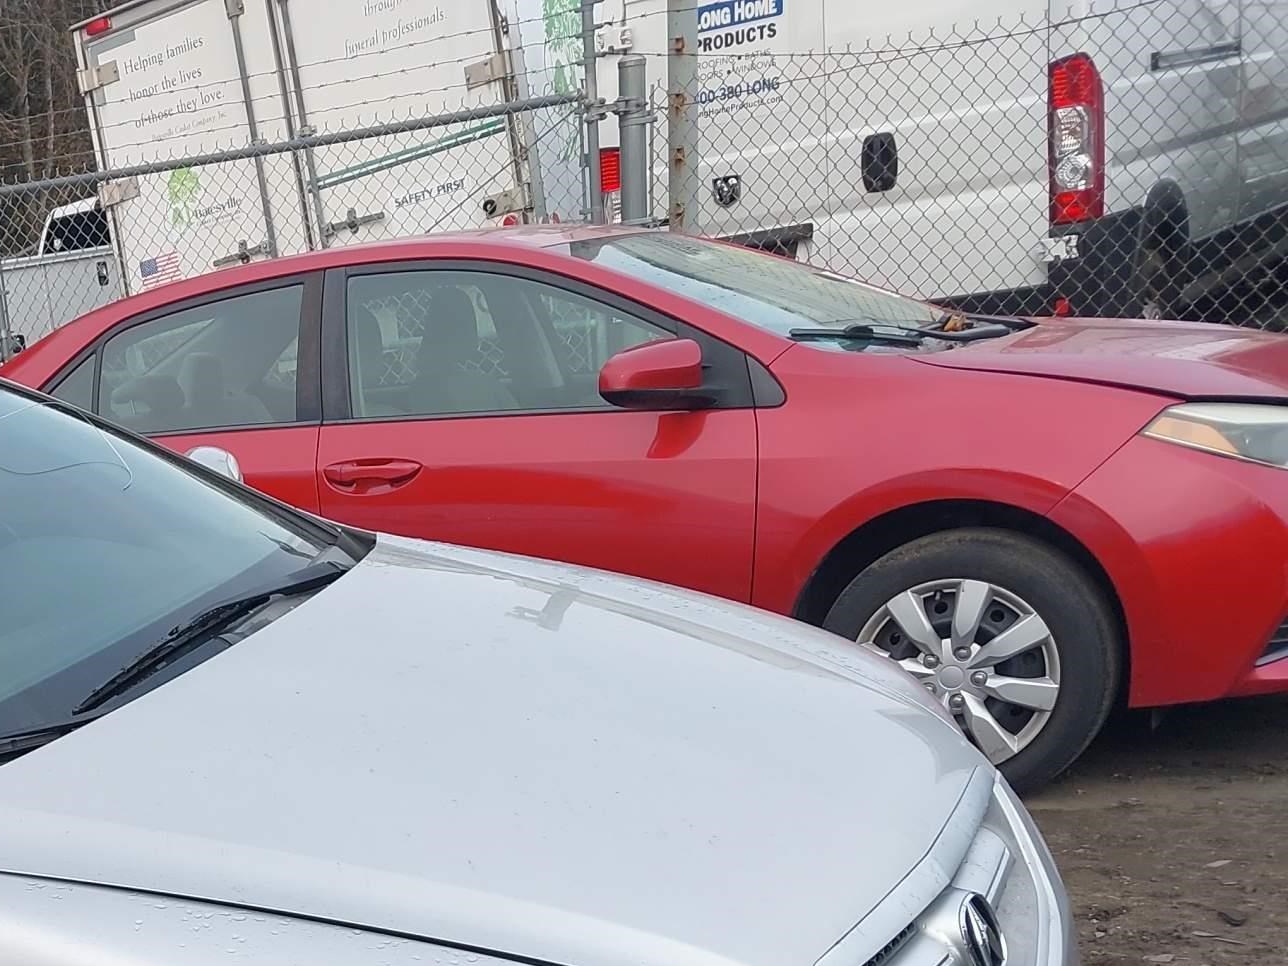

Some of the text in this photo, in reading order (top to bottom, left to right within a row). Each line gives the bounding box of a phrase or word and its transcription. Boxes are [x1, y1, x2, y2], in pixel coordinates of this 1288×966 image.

[734, 0, 777, 22] HOME
[344, 6, 448, 58] funeral professionals.
[123, 37, 204, 75] Helping families
[129, 67, 202, 102] honor the lives
[698, 69, 724, 81] OORS
[135, 89, 225, 129] of those they love.
[394, 178, 465, 208] SAFETY FIRST
